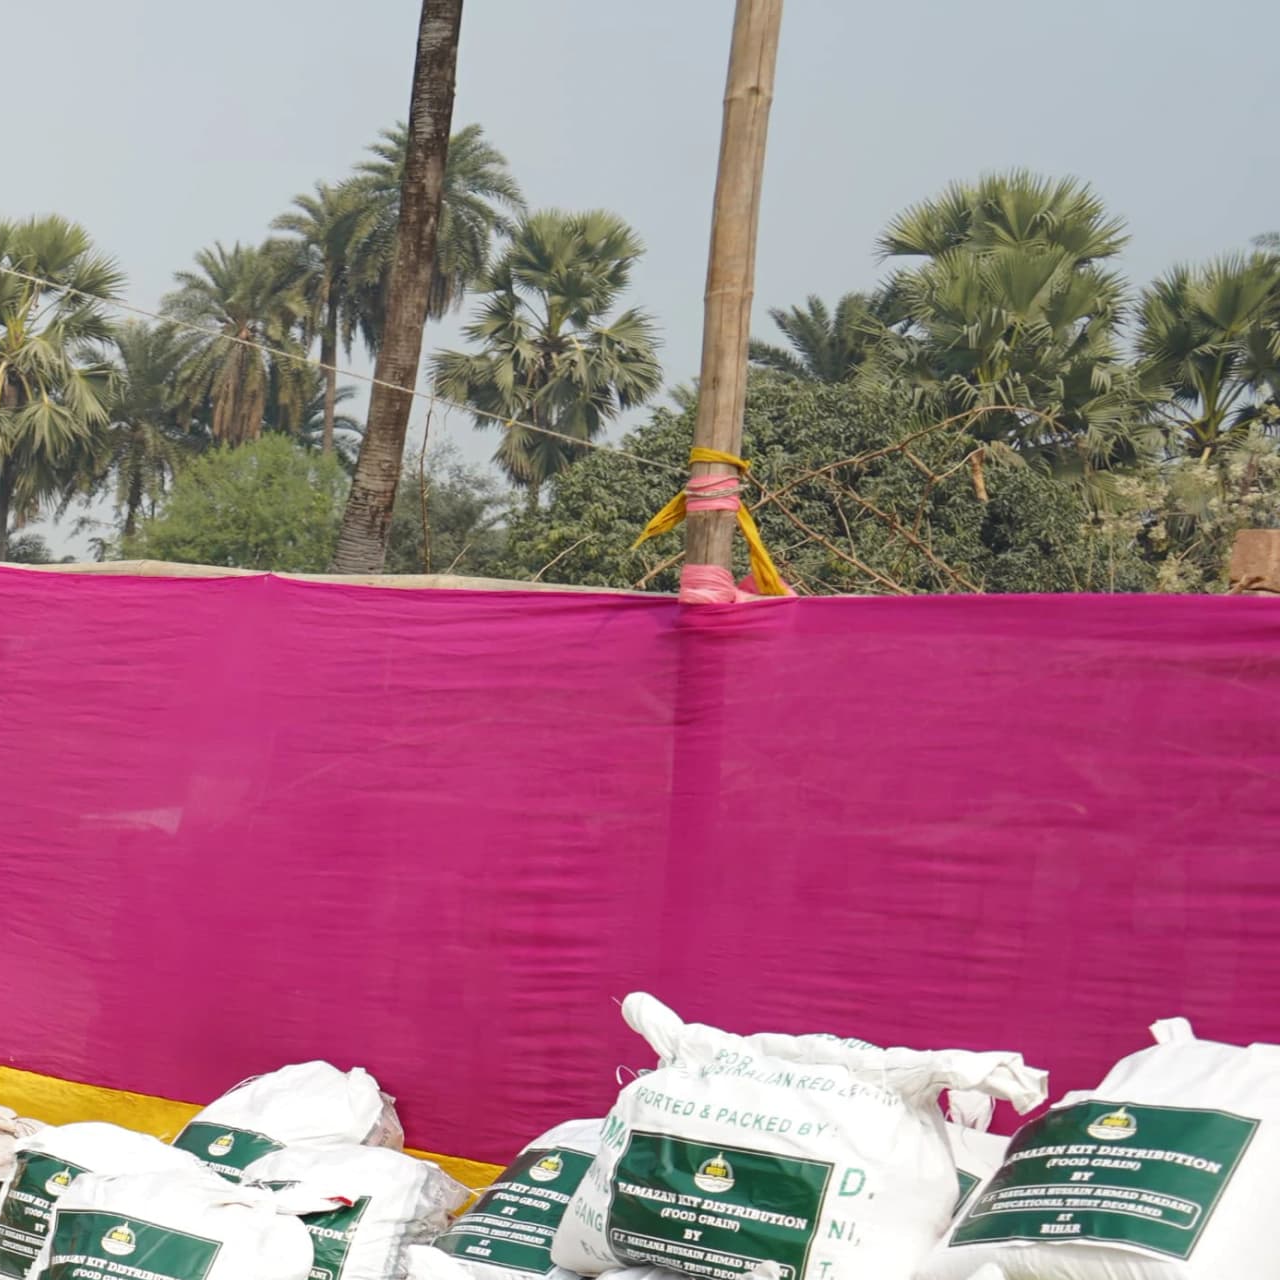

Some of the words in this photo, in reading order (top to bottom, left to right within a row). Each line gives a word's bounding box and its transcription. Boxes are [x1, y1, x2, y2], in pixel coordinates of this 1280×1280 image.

[716, 1108, 793, 1133] PACKED
[1046, 1157, 1090, 1168] (FOOD
[1090, 1158, 1142, 1171] GRAIN)
[1066, 1144, 1097, 1156] KIT
[1096, 1146, 1224, 1174] DISTRIBUTION
[1069, 1171, 1095, 1182] BY
[618, 1182, 677, 1203] RAMAZAN
[678, 1193, 701, 1208] KIT
[701, 1197, 808, 1230] DISTRIBUTION
[1093, 1187, 1140, 1200] AHMAD
[1140, 1193, 1195, 1214] MADANI
[660, 1207, 696, 1222] (FOOD
[699, 1214, 740, 1232] GRAIN)
[1057, 1213, 1074, 1222] AT
[683, 1228, 703, 1242] BY
[1040, 1223, 1081, 1234] BIHAR
[87, 1257, 107, 1269] KIT
[703, 1252, 743, 1269] AHMAD
